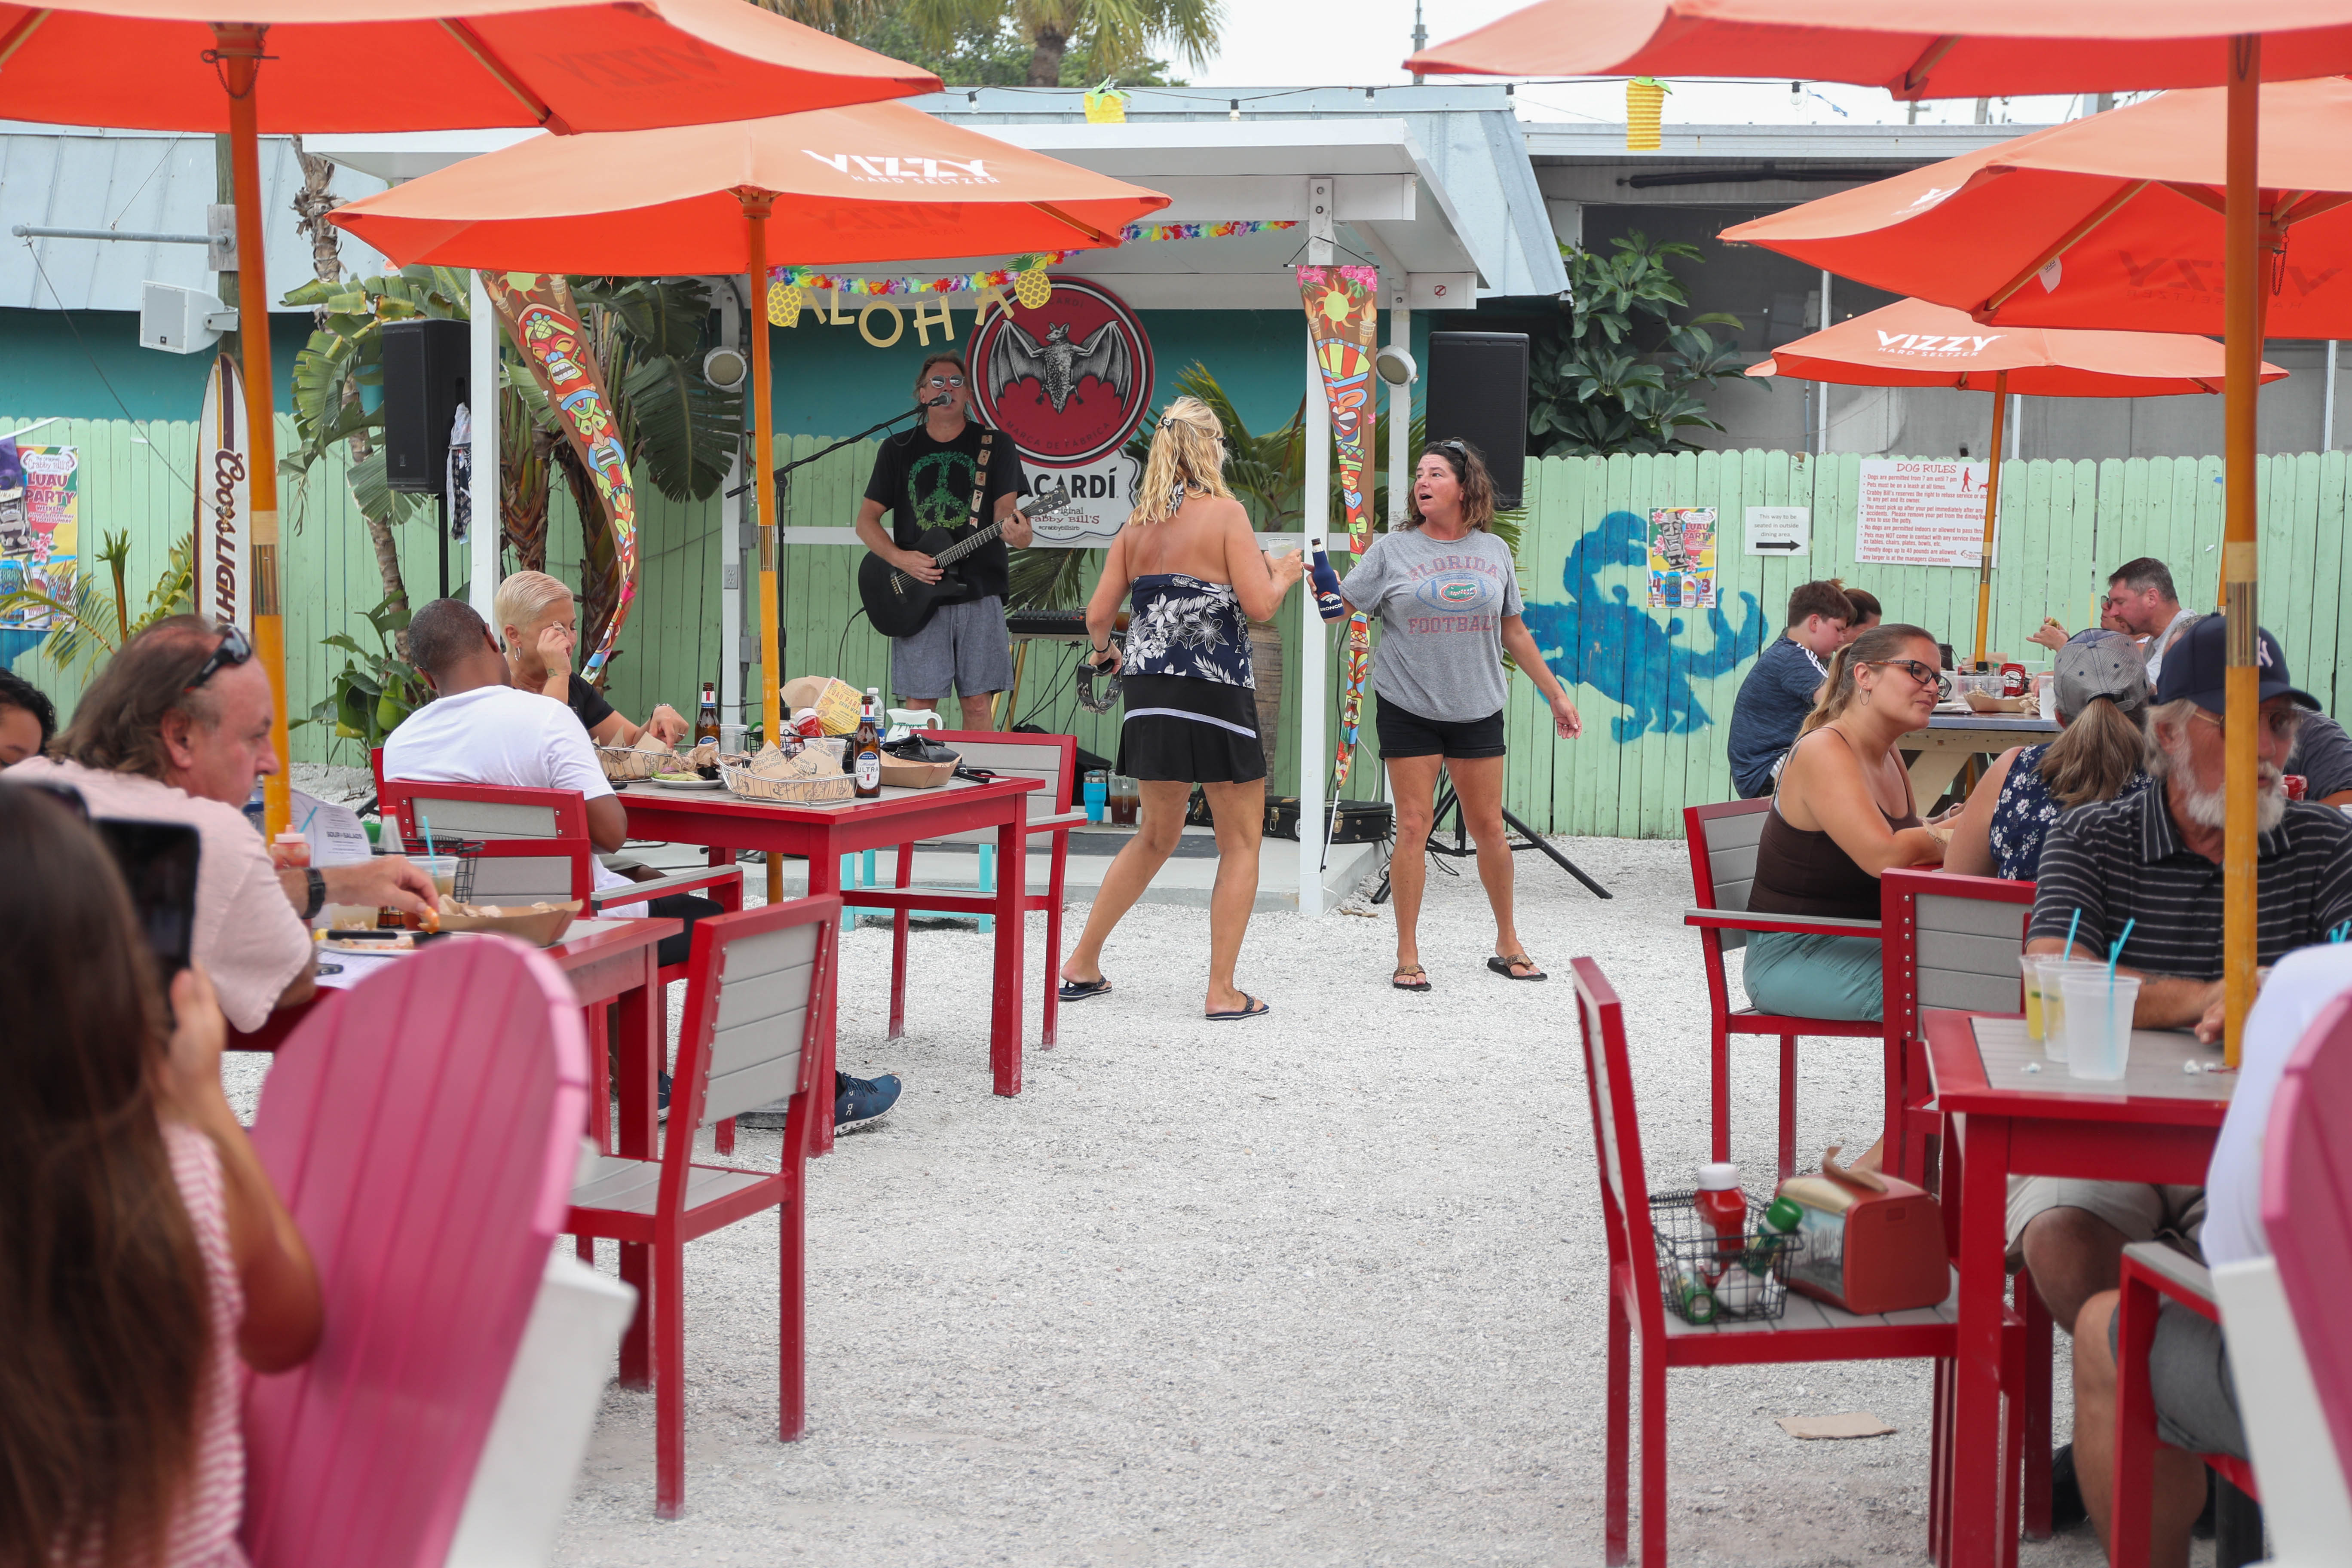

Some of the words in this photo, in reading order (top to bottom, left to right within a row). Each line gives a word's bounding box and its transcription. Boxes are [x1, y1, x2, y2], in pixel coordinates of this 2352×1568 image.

[801, 150, 990, 177] VIZZY
[851, 175, 904, 183] HARD
[1877, 330, 2008, 351] VIZZY
[1878, 347, 1915, 355] HARD
[1006, 420, 1041, 446] MARCA
[28, 458, 51, 470] Crabby
[1897, 463, 1920, 472] DOG
[1923, 464, 1957, 473] RULES
[28, 473, 68, 487] LUAU
[1017, 466, 1118, 499] ACARDÍ
[24, 489, 75, 504] PARTY
[215, 450, 246, 535] Coors
[1406, 555, 1499, 582] FLORIDA
[828, 688, 843, 700] LUAU
